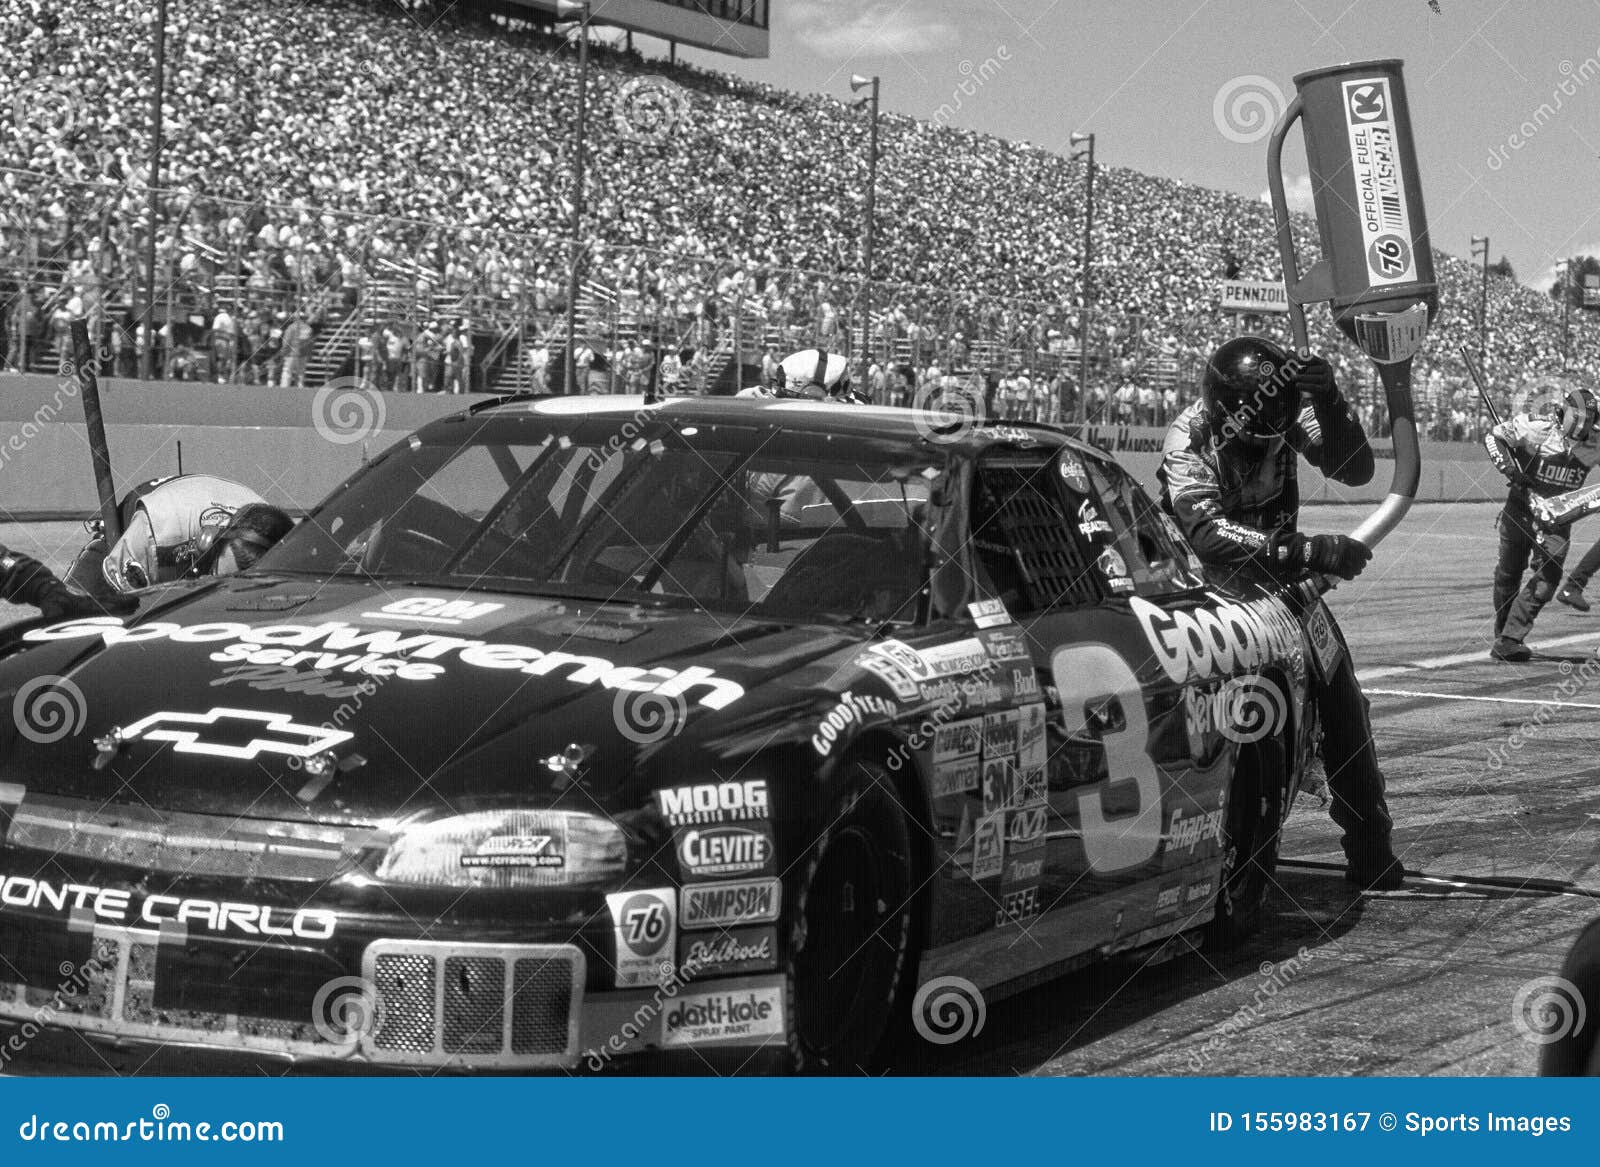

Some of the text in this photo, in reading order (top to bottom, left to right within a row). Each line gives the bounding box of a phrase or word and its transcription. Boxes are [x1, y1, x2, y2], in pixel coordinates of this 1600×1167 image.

[1355, 129, 1379, 233] OFFICIAL FUEL
[1374, 239, 1404, 276] 76
[1226, 286, 1287, 303] PENNZOIL
[1537, 460, 1586, 484] LOWE'S
[381, 597, 506, 620] GM
[22, 615, 745, 711] Goodwrench
[210, 642, 446, 680] Service
[811, 691, 897, 757] GOODYEAR
[1052, 640, 1163, 875] 3
[659, 779, 768, 816] MOOG
[461, 855, 563, 868] www.rcrracing.com
[682, 830, 766, 867] CLEVITE
[0, 875, 338, 940] ONTE CARLO
[626, 900, 666, 944] 76
[687, 885, 773, 922] SIMPSON
